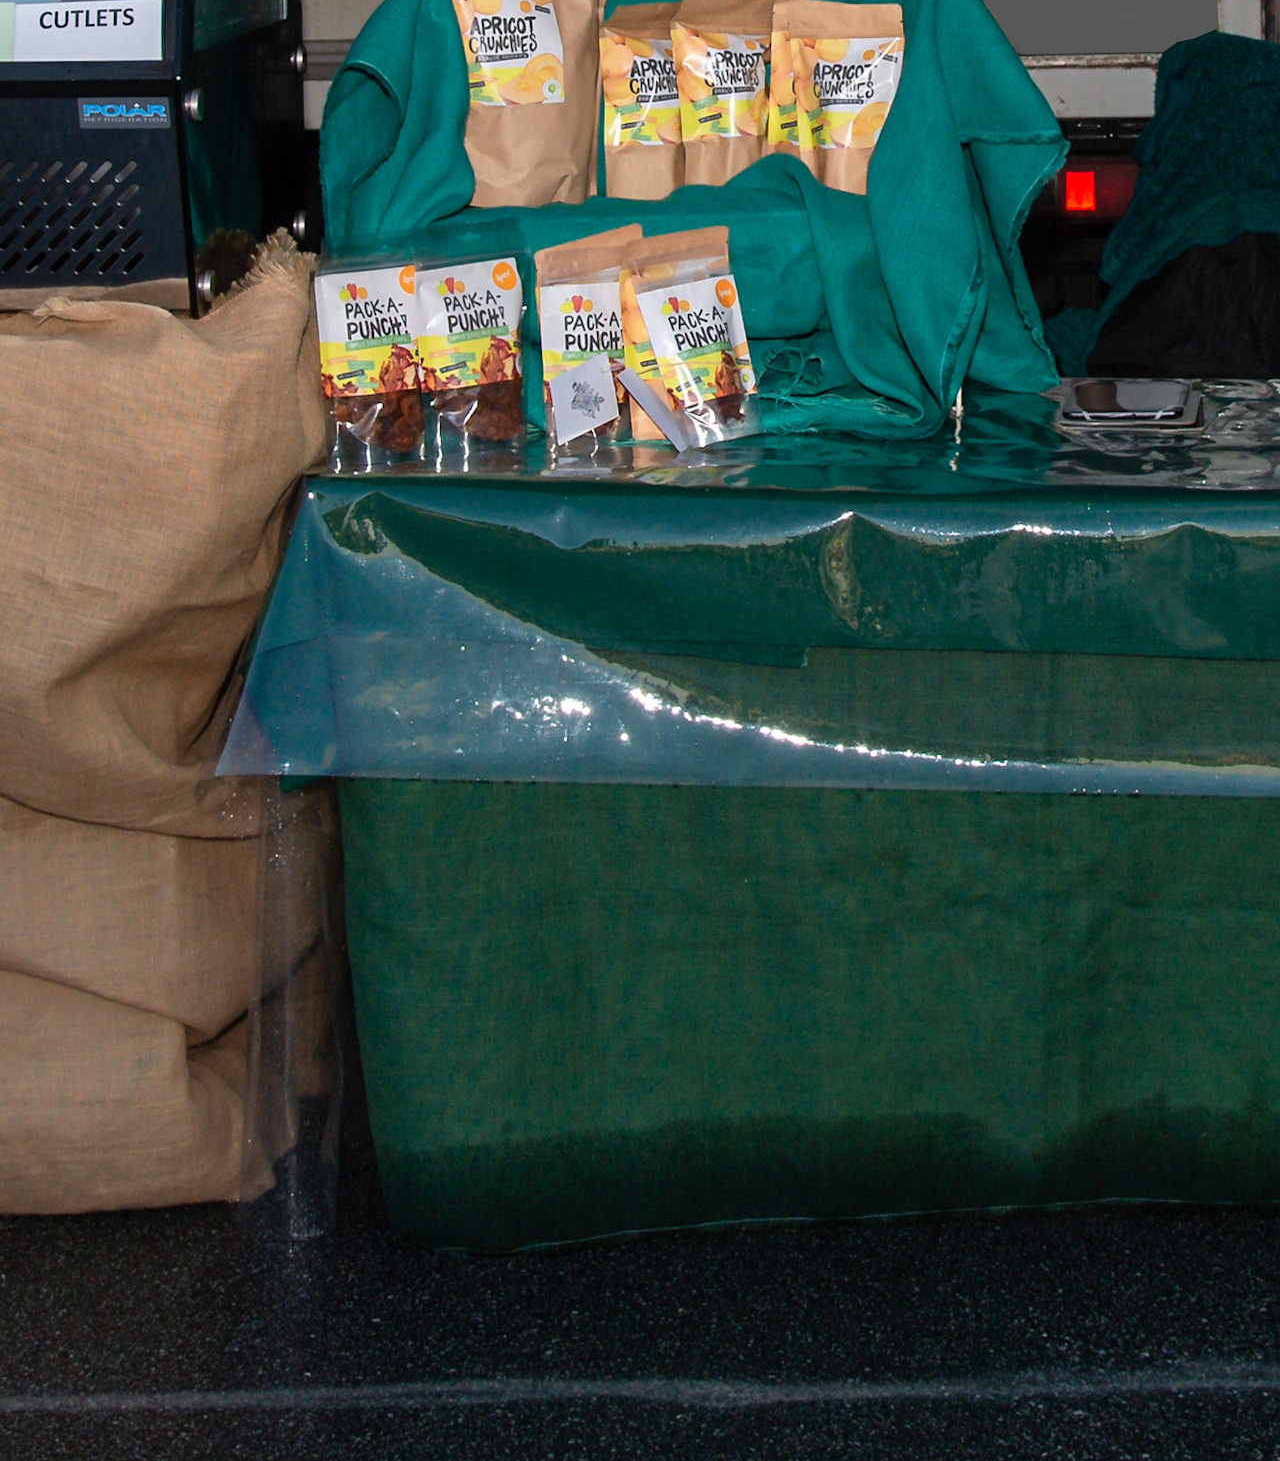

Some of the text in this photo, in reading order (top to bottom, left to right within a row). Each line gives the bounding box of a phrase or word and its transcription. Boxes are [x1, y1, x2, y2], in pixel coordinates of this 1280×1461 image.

[39, 8, 135, 29] CUTLETS
[470, 16, 536, 36] APRICOT
[469, 33, 538, 54] CRUNCHIES
[83, 103, 166, 117] POLAR
[345, 297, 404, 319] PACK-A-
[443, 290, 502, 312] PACK-A-
[347, 314, 408, 340] PUNCH!
[448, 306, 506, 333] PUNCH!
[564, 311, 622, 332] PACK-A
[668, 305, 725, 331] PACK-A-
